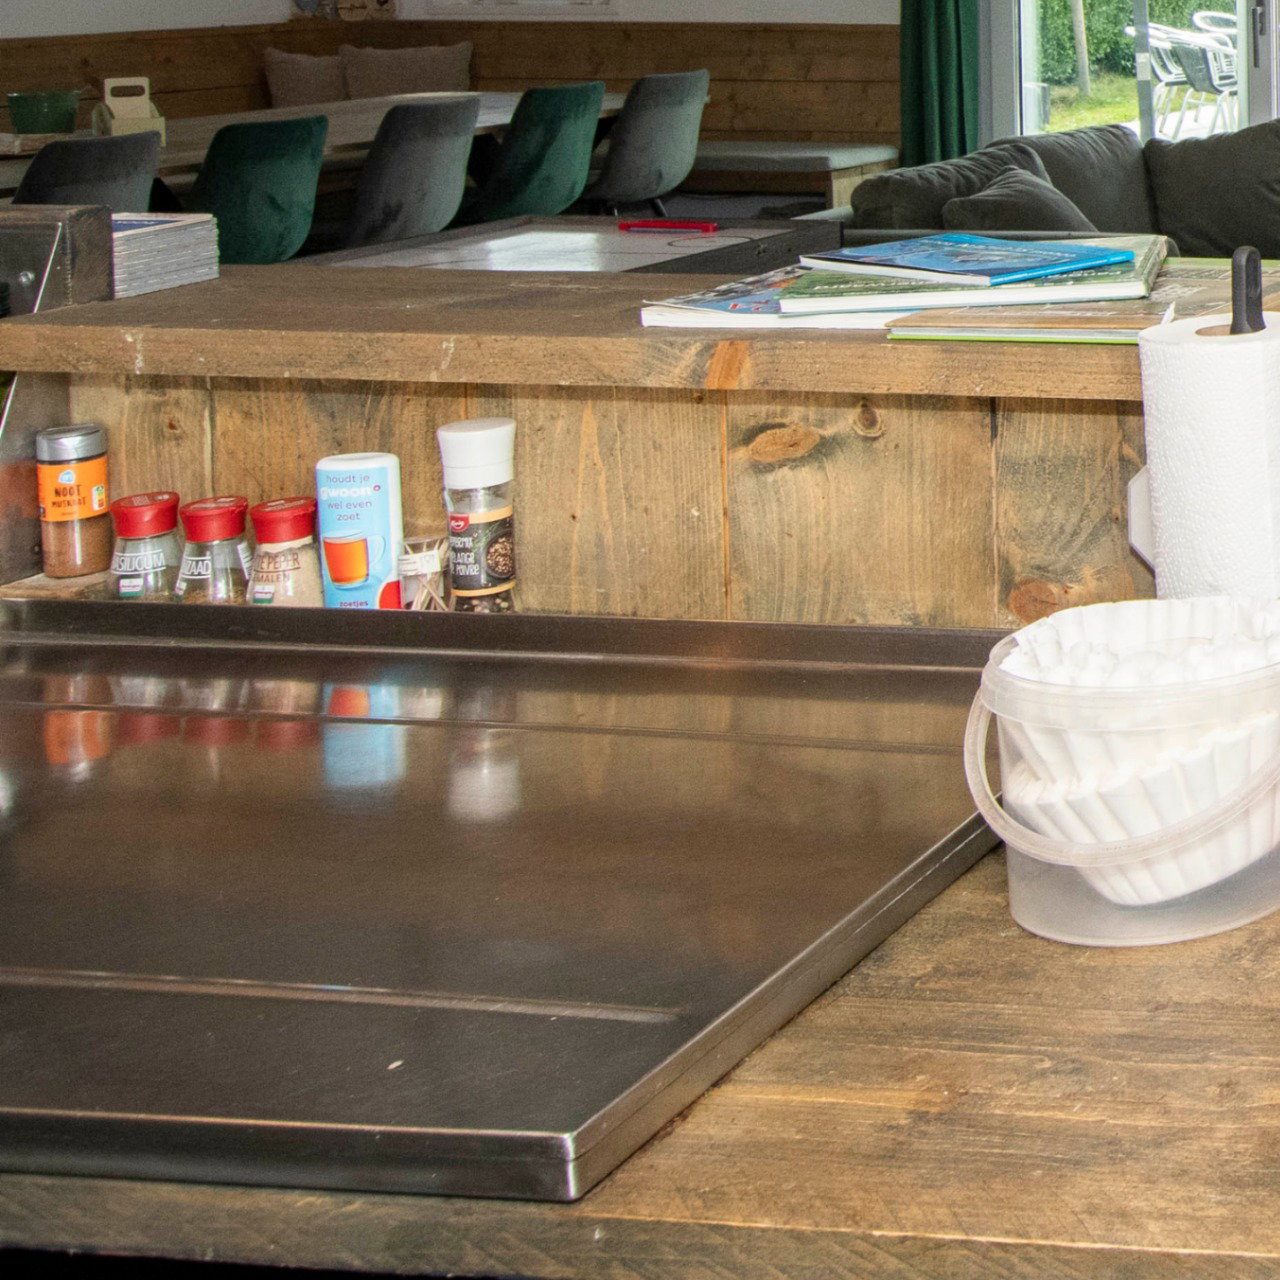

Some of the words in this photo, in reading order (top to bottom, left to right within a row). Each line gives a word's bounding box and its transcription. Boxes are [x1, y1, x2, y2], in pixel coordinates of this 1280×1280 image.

[326, 474, 356, 484] houdt
[360, 473, 370, 484] je
[54, 485, 82, 497] NOOT
[320, 485, 372, 500] gwoon
[327, 502, 343, 510] wel
[345, 500, 372, 509] even
[336, 512, 361, 521] zoet
